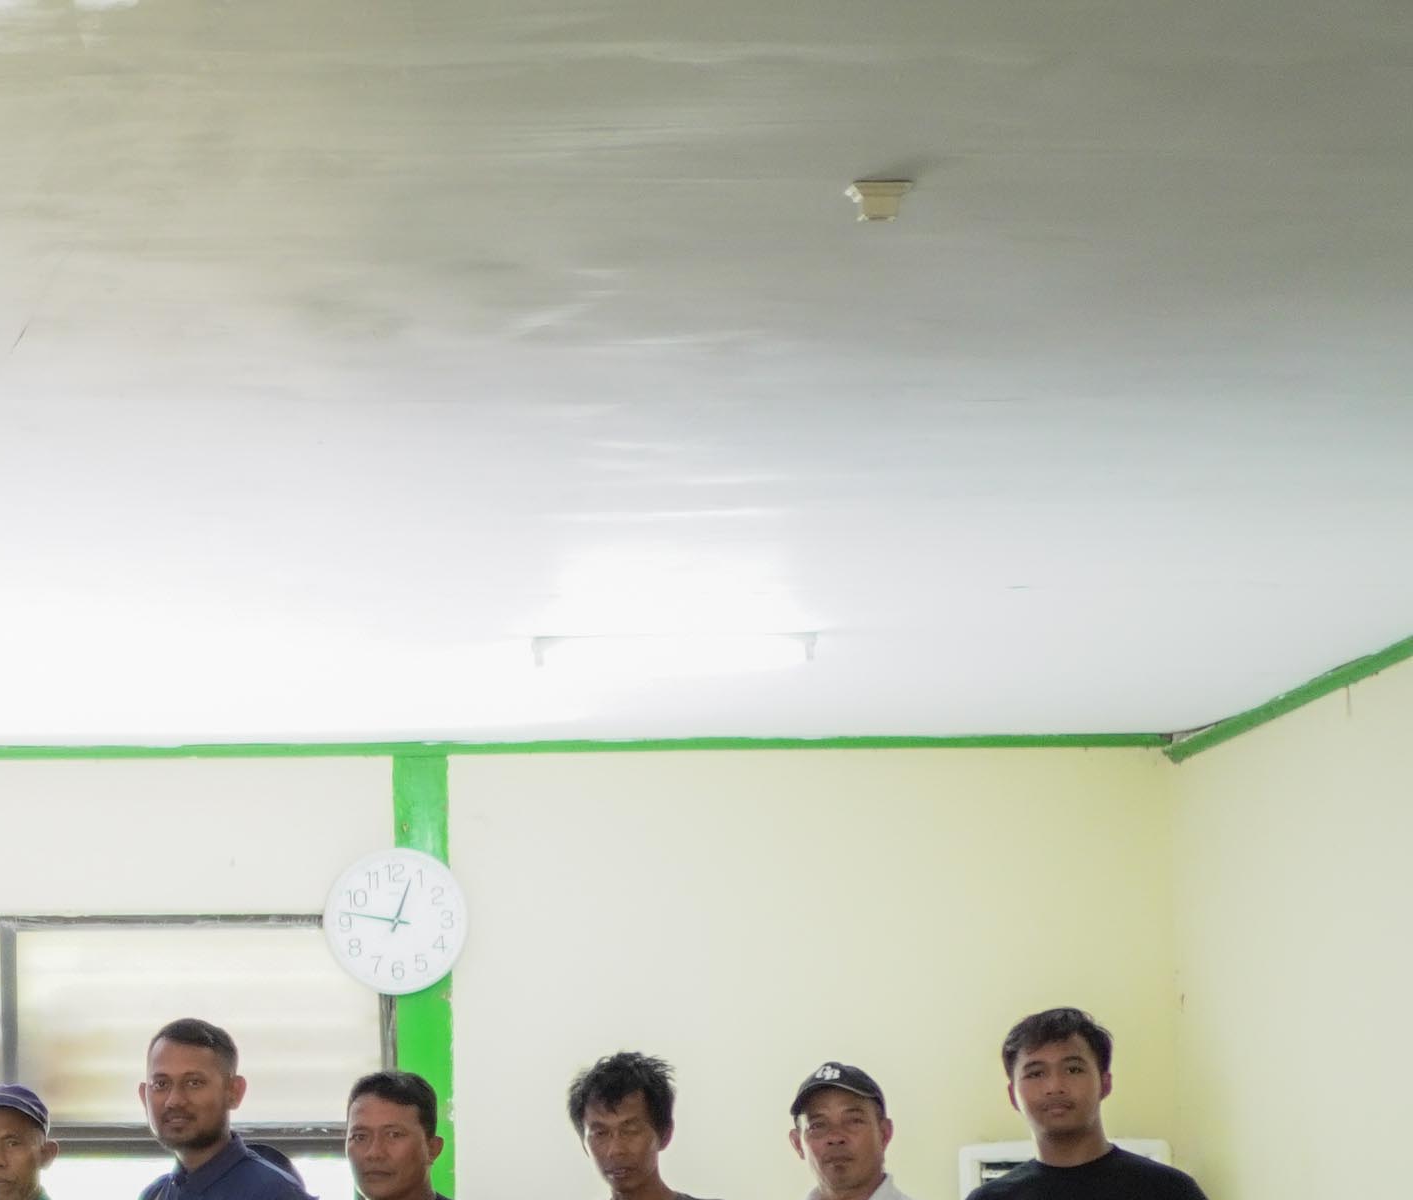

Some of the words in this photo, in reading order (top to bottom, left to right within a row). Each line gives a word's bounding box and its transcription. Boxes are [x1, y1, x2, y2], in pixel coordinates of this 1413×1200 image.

[365, 871, 379, 889] 11
[386, 864, 405, 883] 12
[417, 869, 423, 888] 1
[346, 889, 368, 908] 10
[431, 886, 444, 905] 2
[339, 912, 352, 932] 9
[441, 910, 453, 929] 3
[348, 938, 361, 957] 8
[432, 935, 447, 953] 4
[371, 955, 382, 975] 7
[391, 960, 405, 981] 6
[415, 954, 428, 972] 5
